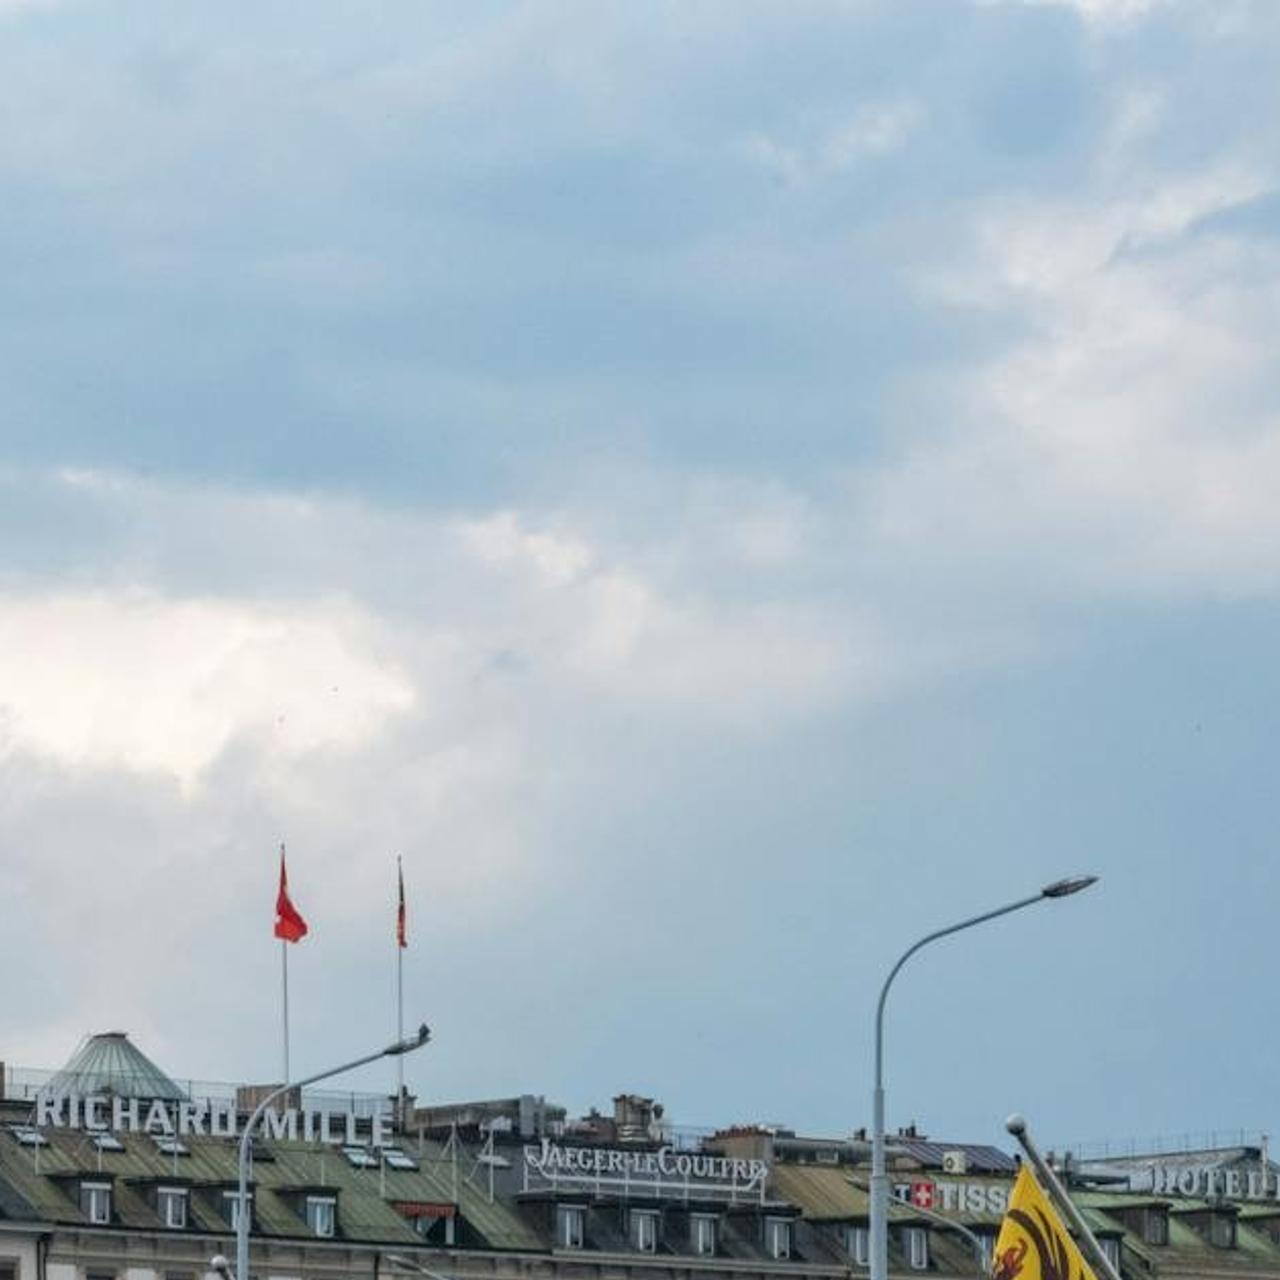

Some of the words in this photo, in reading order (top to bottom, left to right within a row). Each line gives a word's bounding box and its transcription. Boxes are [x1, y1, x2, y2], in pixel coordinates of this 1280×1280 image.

[36, 1094, 238, 1137] RICHARD
[262, 1106, 396, 1147] MILLE
[935, 1182, 1009, 1213] TISS
